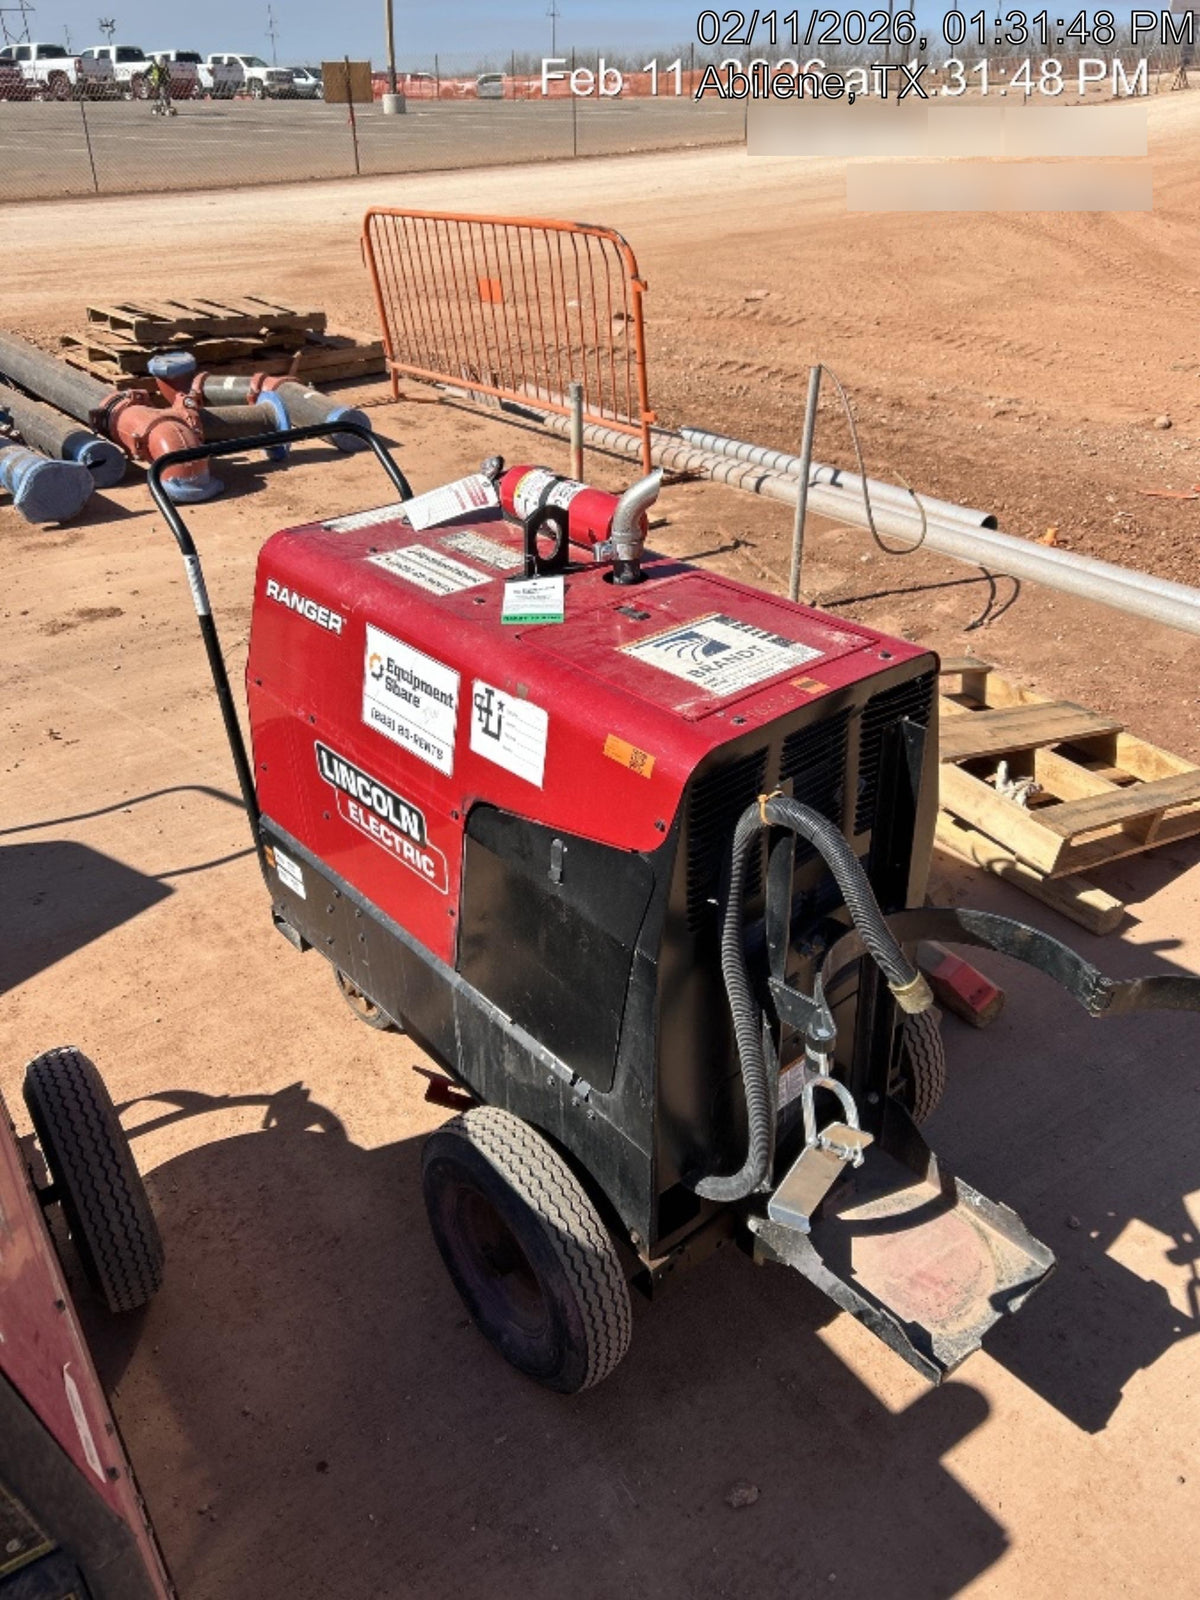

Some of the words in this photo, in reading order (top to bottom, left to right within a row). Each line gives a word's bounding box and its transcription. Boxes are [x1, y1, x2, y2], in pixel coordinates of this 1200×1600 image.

[266, 579, 343, 636] RANGER
[385, 675, 421, 709] Share
[386, 656, 454, 710] Equipment
[320, 749, 421, 842] LINCOLN
[347, 799, 436, 879] ELECTRIC
